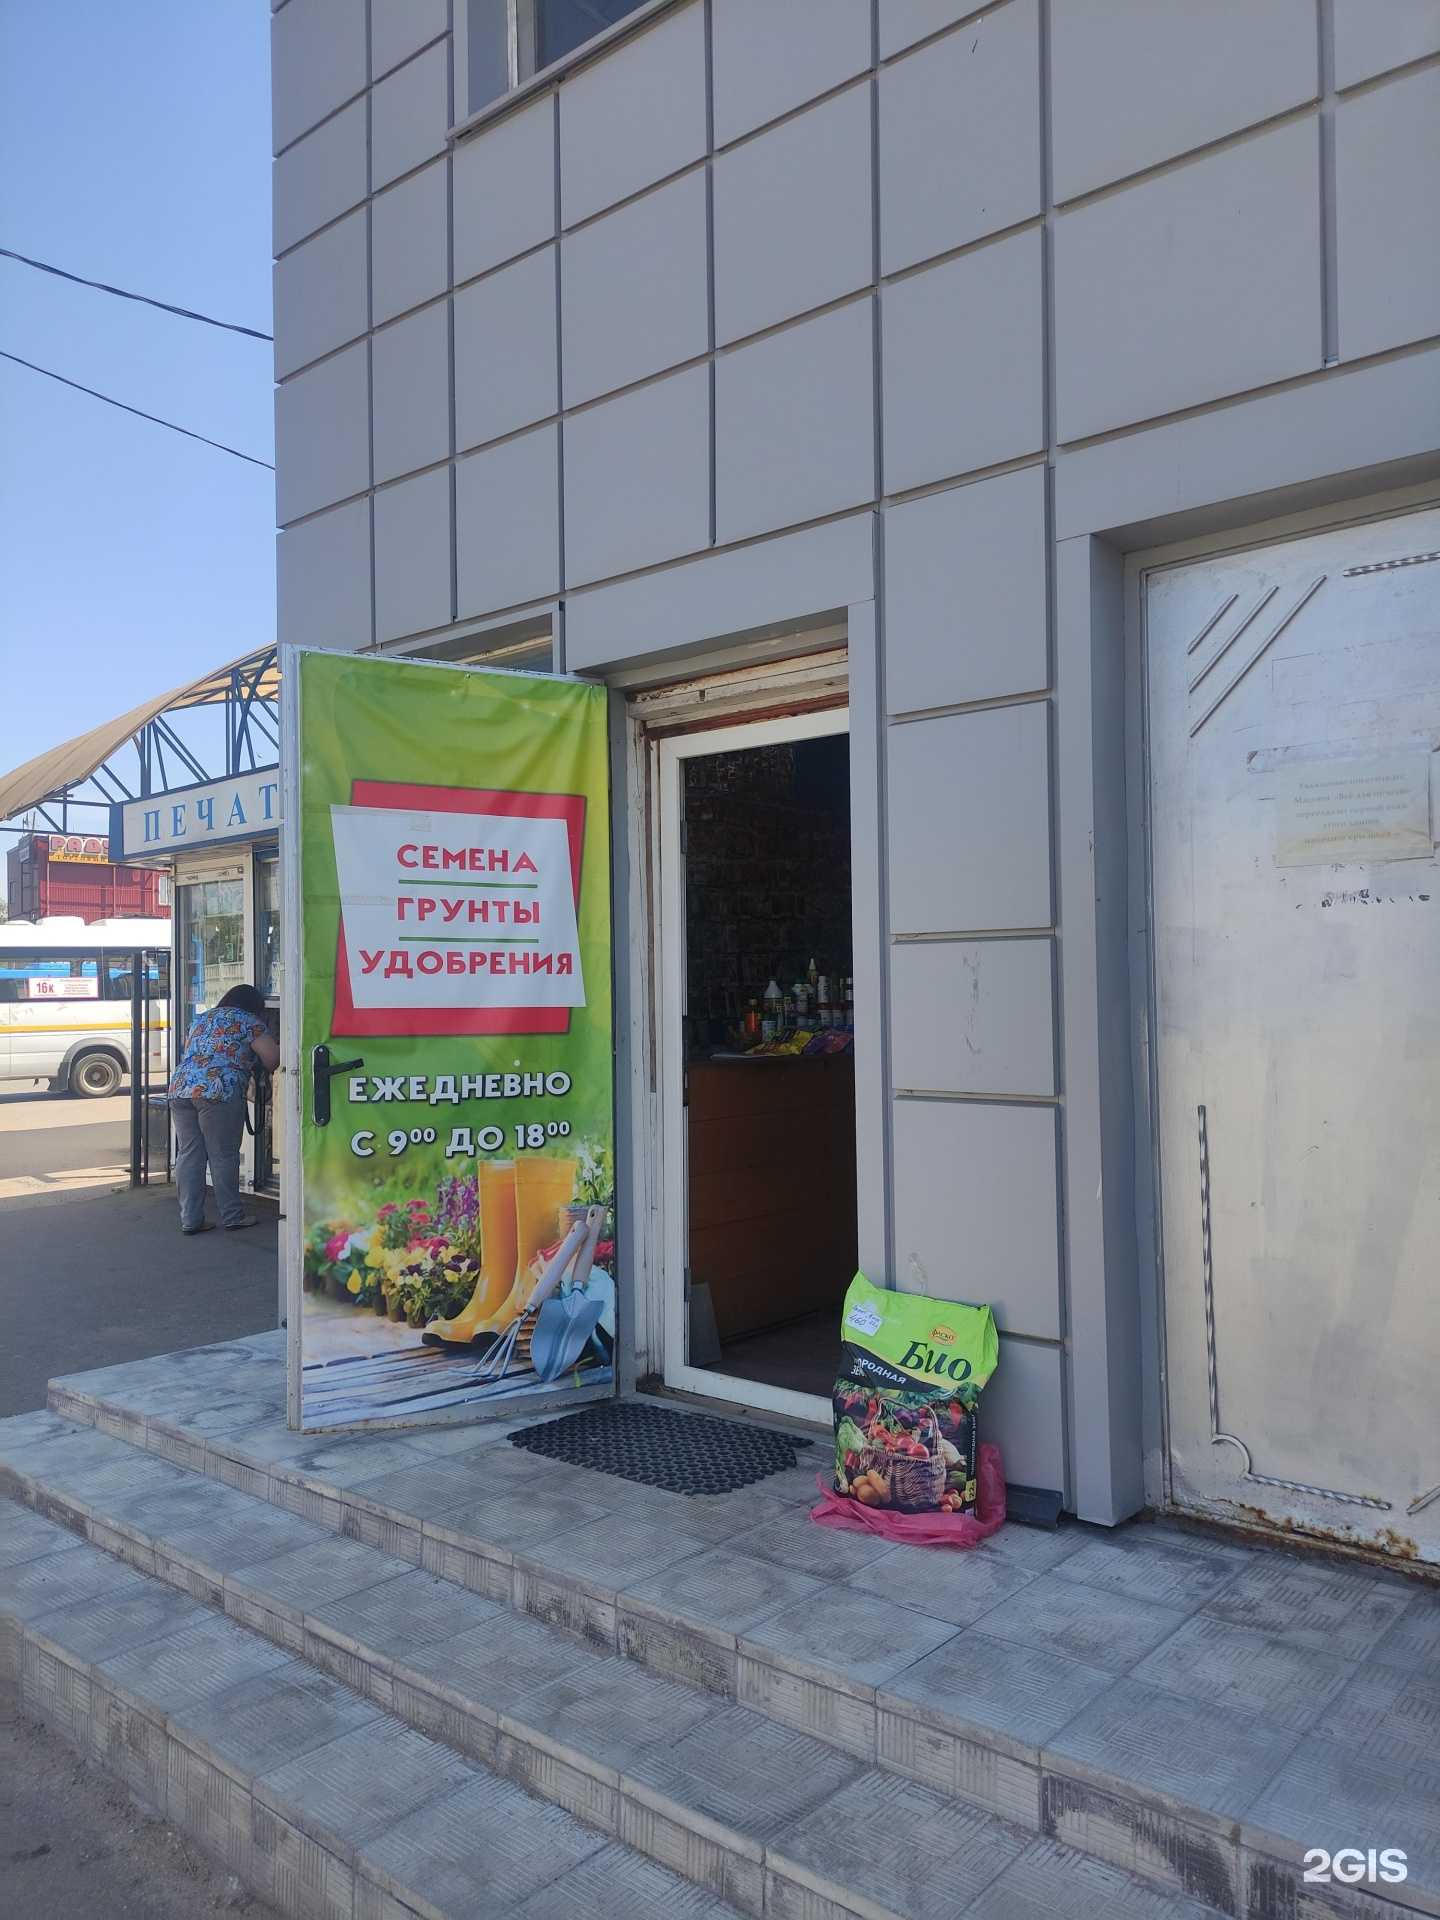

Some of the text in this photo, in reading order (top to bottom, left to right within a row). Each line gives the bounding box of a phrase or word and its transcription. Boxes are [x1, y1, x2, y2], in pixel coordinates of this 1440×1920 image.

[396, 843, 538, 873] СЕМЕНА
[397, 897, 541, 925] ГРУНТЫ
[358, 950, 573, 979] УДОБРЕНИЯ
[349, 1071, 571, 1105] ЕЖЕДНЕВНО
[351, 1131, 375, 1156] С
[445, 1126, 504, 1157] ДО
[896, 1340, 972, 1381] Био
